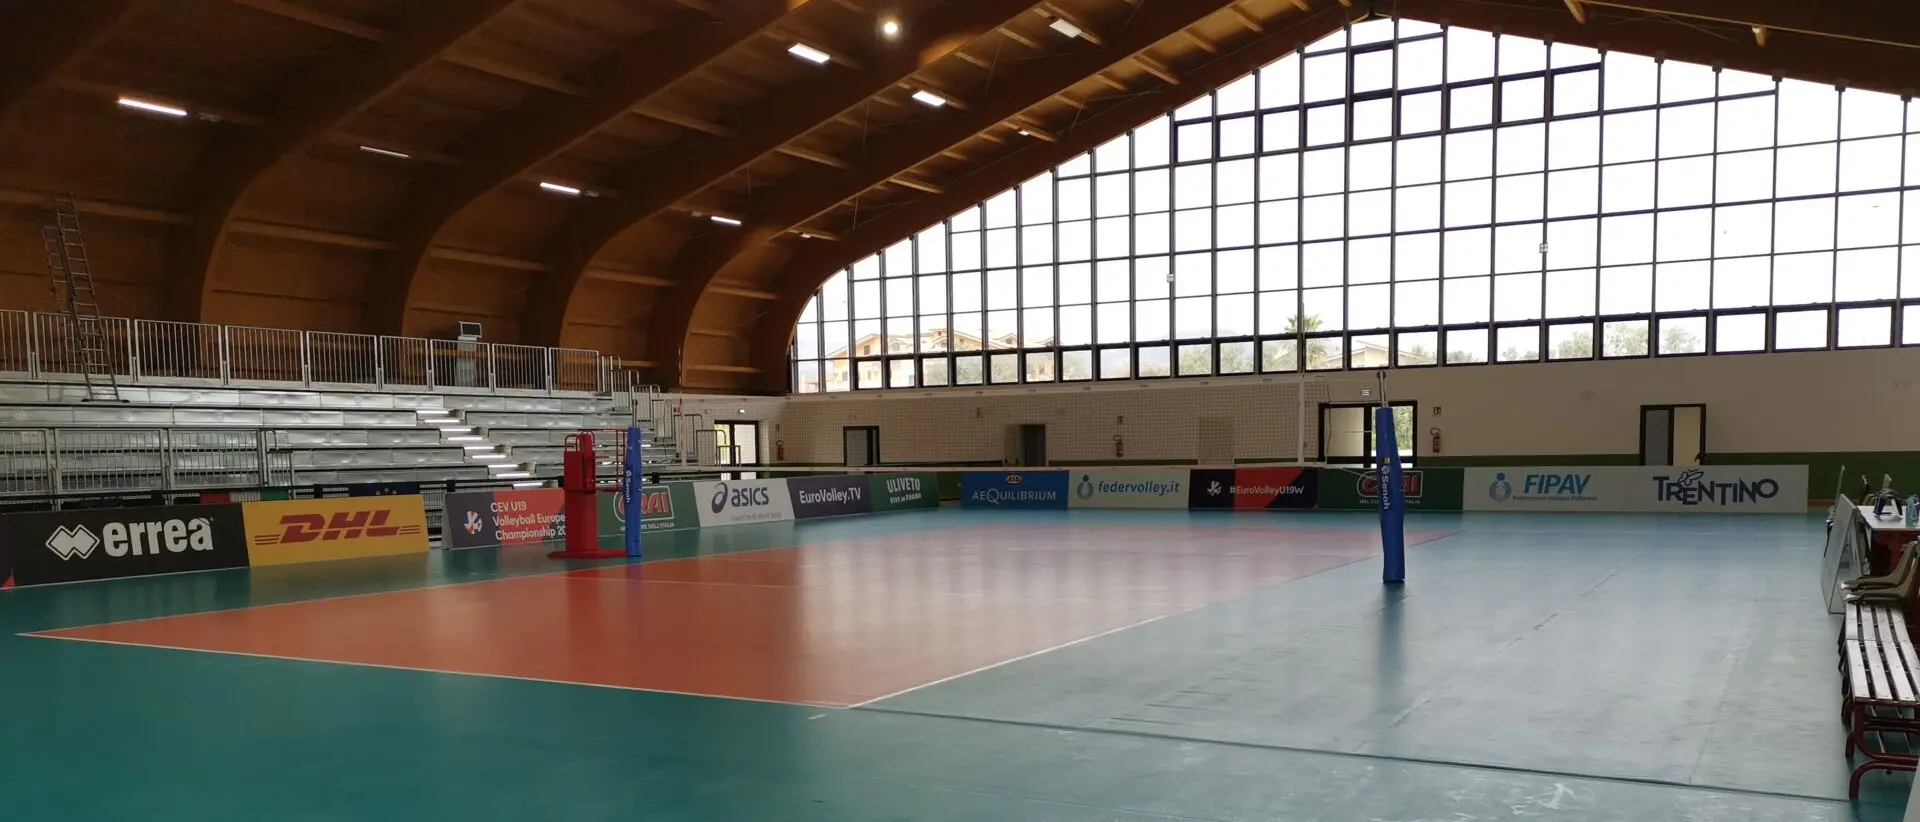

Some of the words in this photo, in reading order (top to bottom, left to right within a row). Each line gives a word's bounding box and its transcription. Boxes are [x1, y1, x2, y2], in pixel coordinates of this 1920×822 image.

[886, 477, 921, 493] ULIVETO
[1098, 480, 1180, 496] federvolley.it
[1229, 485, 1305, 496] #EuroVolleyU19W
[1382, 475, 1391, 510] Senoh
[1523, 474, 1592, 494] FIPAV
[1652, 475, 1779, 506] TRENTINO
[731, 486, 769, 507] asics
[799, 487, 861, 504] EuroVolley.TV
[972, 488, 1056, 505] AEQUILIBRIUM
[490, 501, 509, 513] CEV
[511, 500, 527, 512] U19
[279, 509, 400, 544] DHL
[492, 514, 535, 528] Volleyball
[536, 514, 565, 525] Europe
[495, 526, 556, 541] Championship
